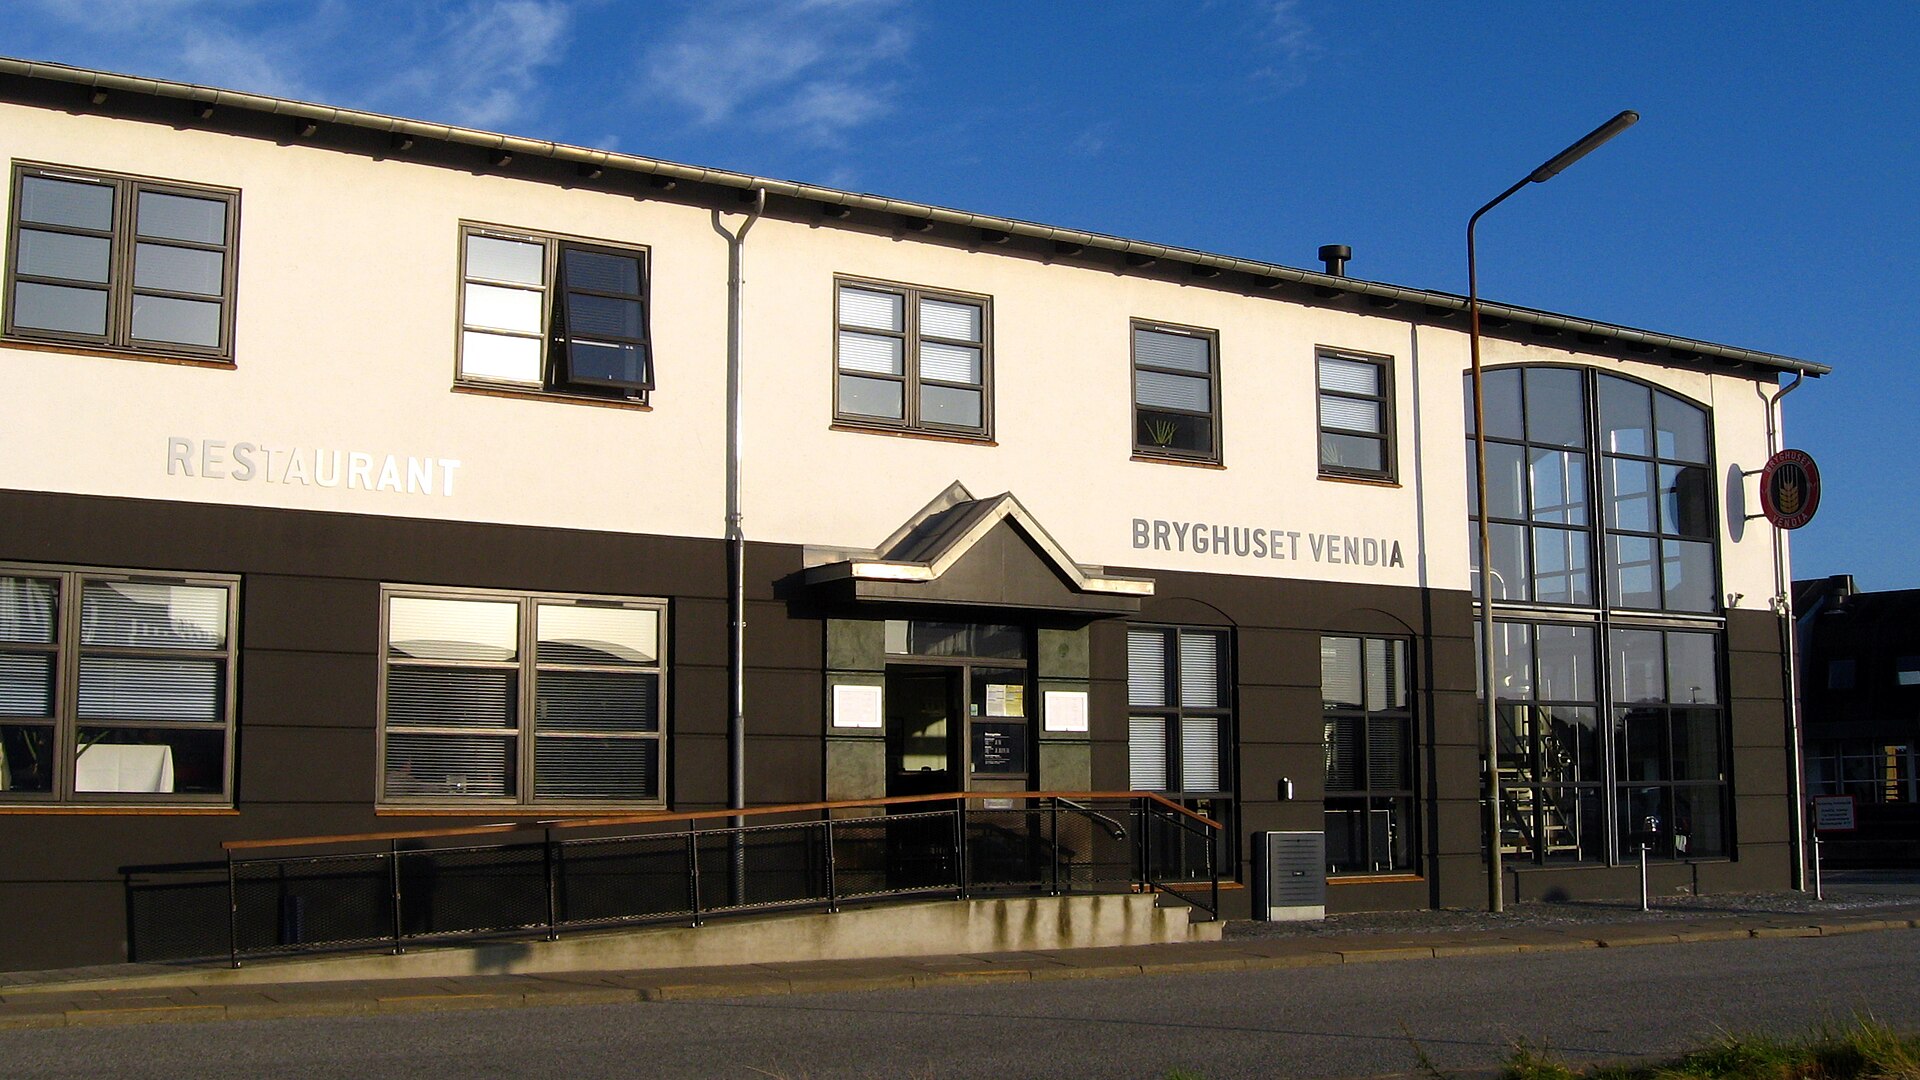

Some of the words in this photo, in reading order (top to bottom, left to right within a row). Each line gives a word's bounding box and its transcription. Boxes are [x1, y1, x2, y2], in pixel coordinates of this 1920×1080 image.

[166, 436, 462, 497] RESTAURANT
[1765, 451, 1811, 473] BRYGHUSET
[1772, 514, 1808, 528] VENDIA
[1132, 518, 1301, 560] BRYGHUSET
[1308, 533, 1405, 568] VENDIA
